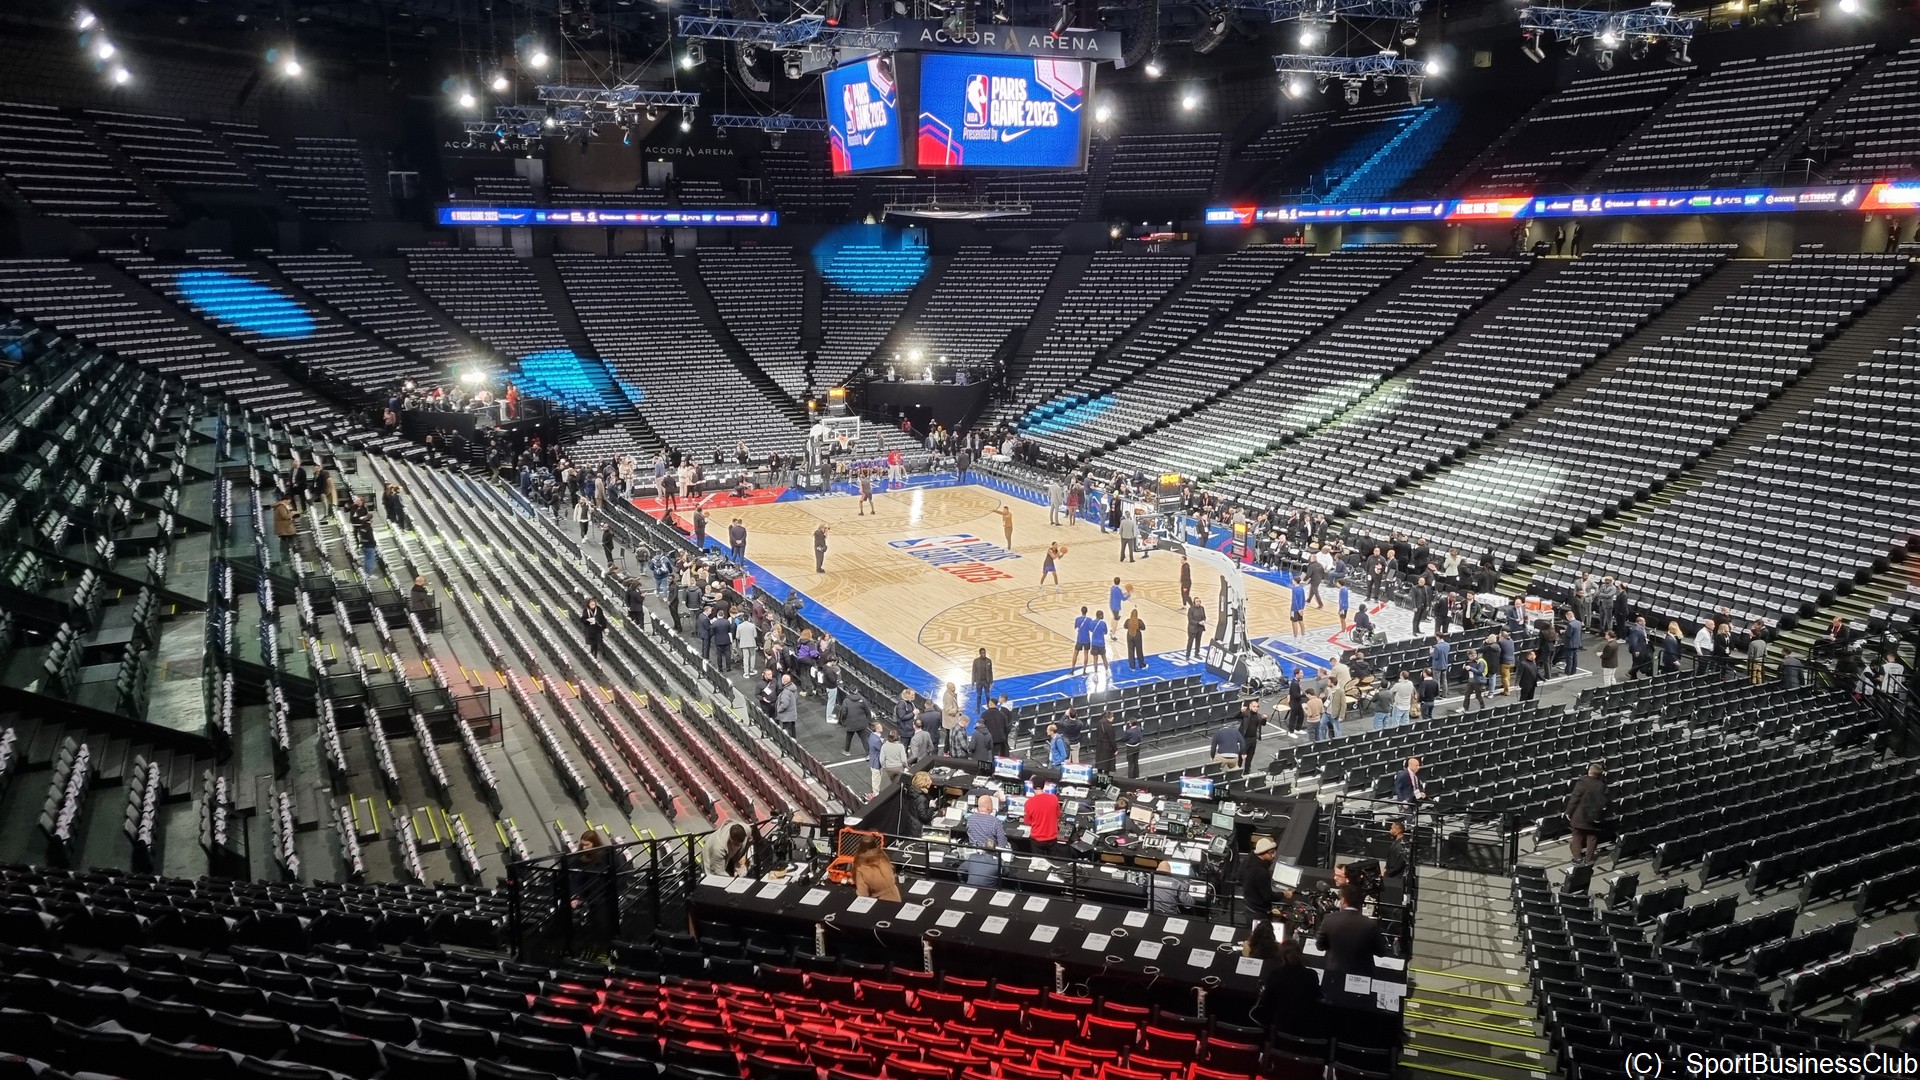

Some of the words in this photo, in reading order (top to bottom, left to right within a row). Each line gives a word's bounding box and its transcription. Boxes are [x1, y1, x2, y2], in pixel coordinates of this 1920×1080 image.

[1028, 35, 1099, 51] ARENA
[991, 76, 1027, 101] PARIS
[966, 112, 979, 122] NBA
[990, 100, 1025, 127] GAME
[1025, 101, 1058, 127] 2023
[963, 127, 991, 140] Presented
[990, 127, 998, 142] by
[645, 146, 682, 155] ACCOR
[698, 148, 734, 156] ARENA
[938, 562, 1014, 583] 2023
